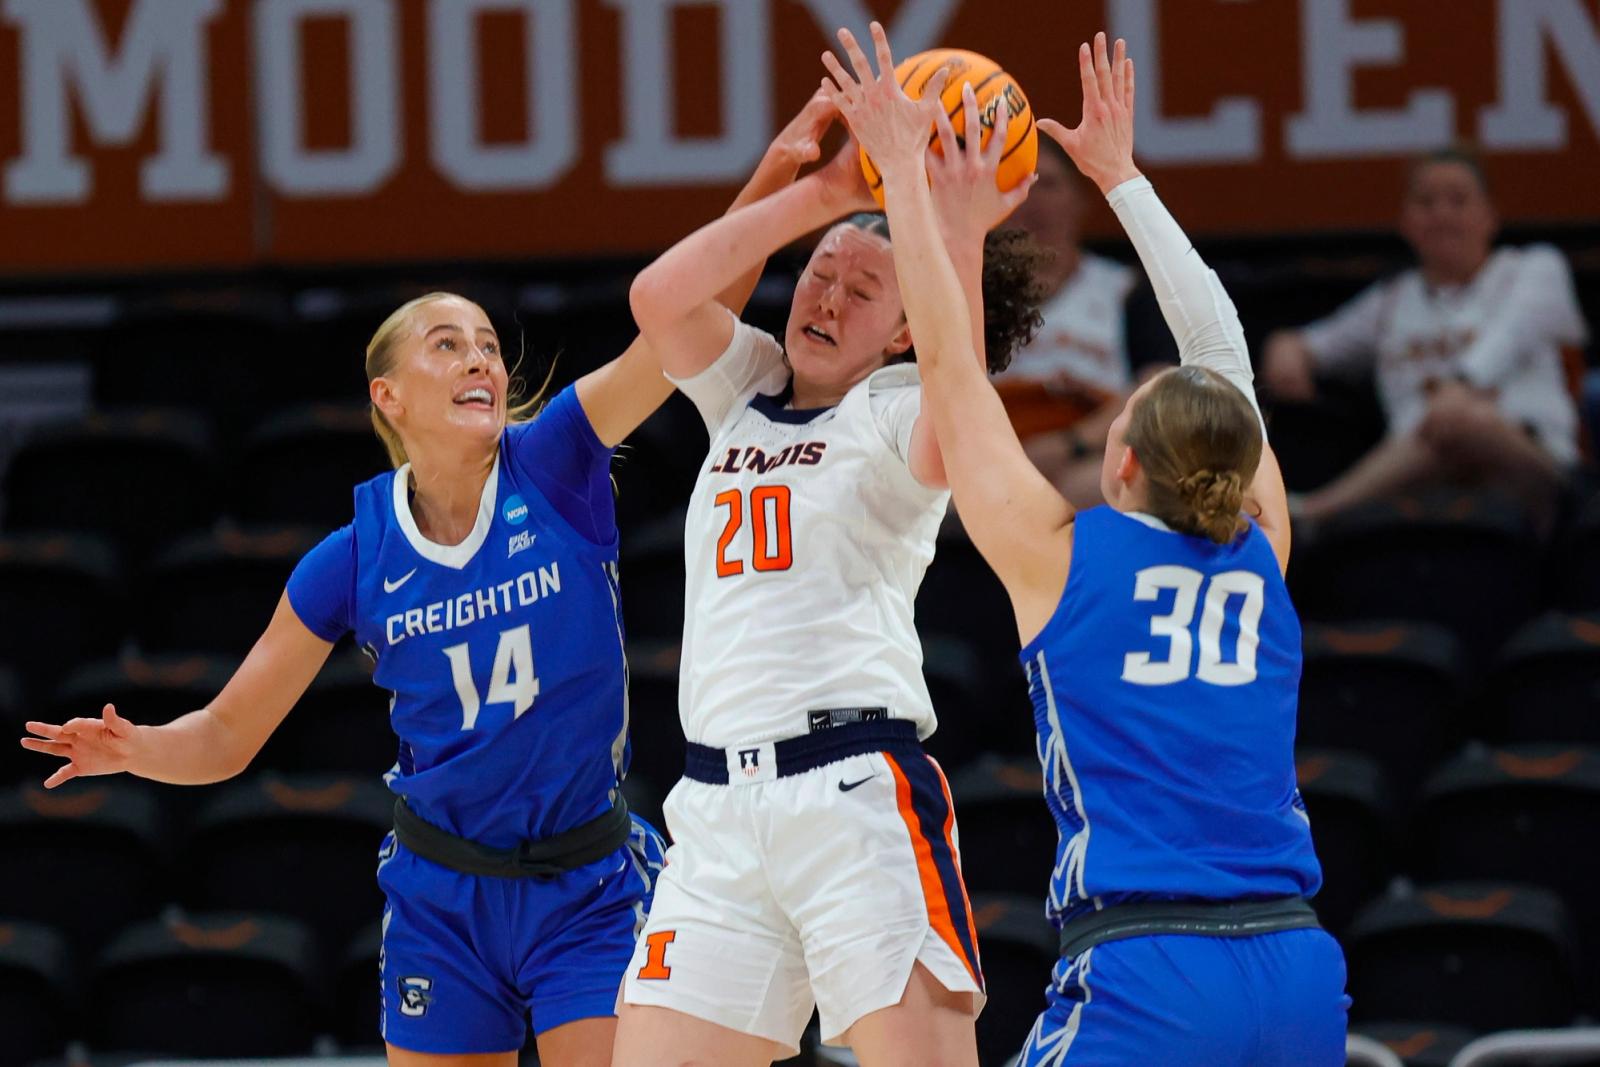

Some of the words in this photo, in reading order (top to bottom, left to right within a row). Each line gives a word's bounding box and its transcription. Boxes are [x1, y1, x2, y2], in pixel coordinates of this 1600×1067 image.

[714, 484, 793, 578] 20
[386, 561, 561, 646] CREIGHTON
[1120, 564, 1265, 686] 30
[442, 623, 540, 731] 14
[637, 929, 677, 980] I
